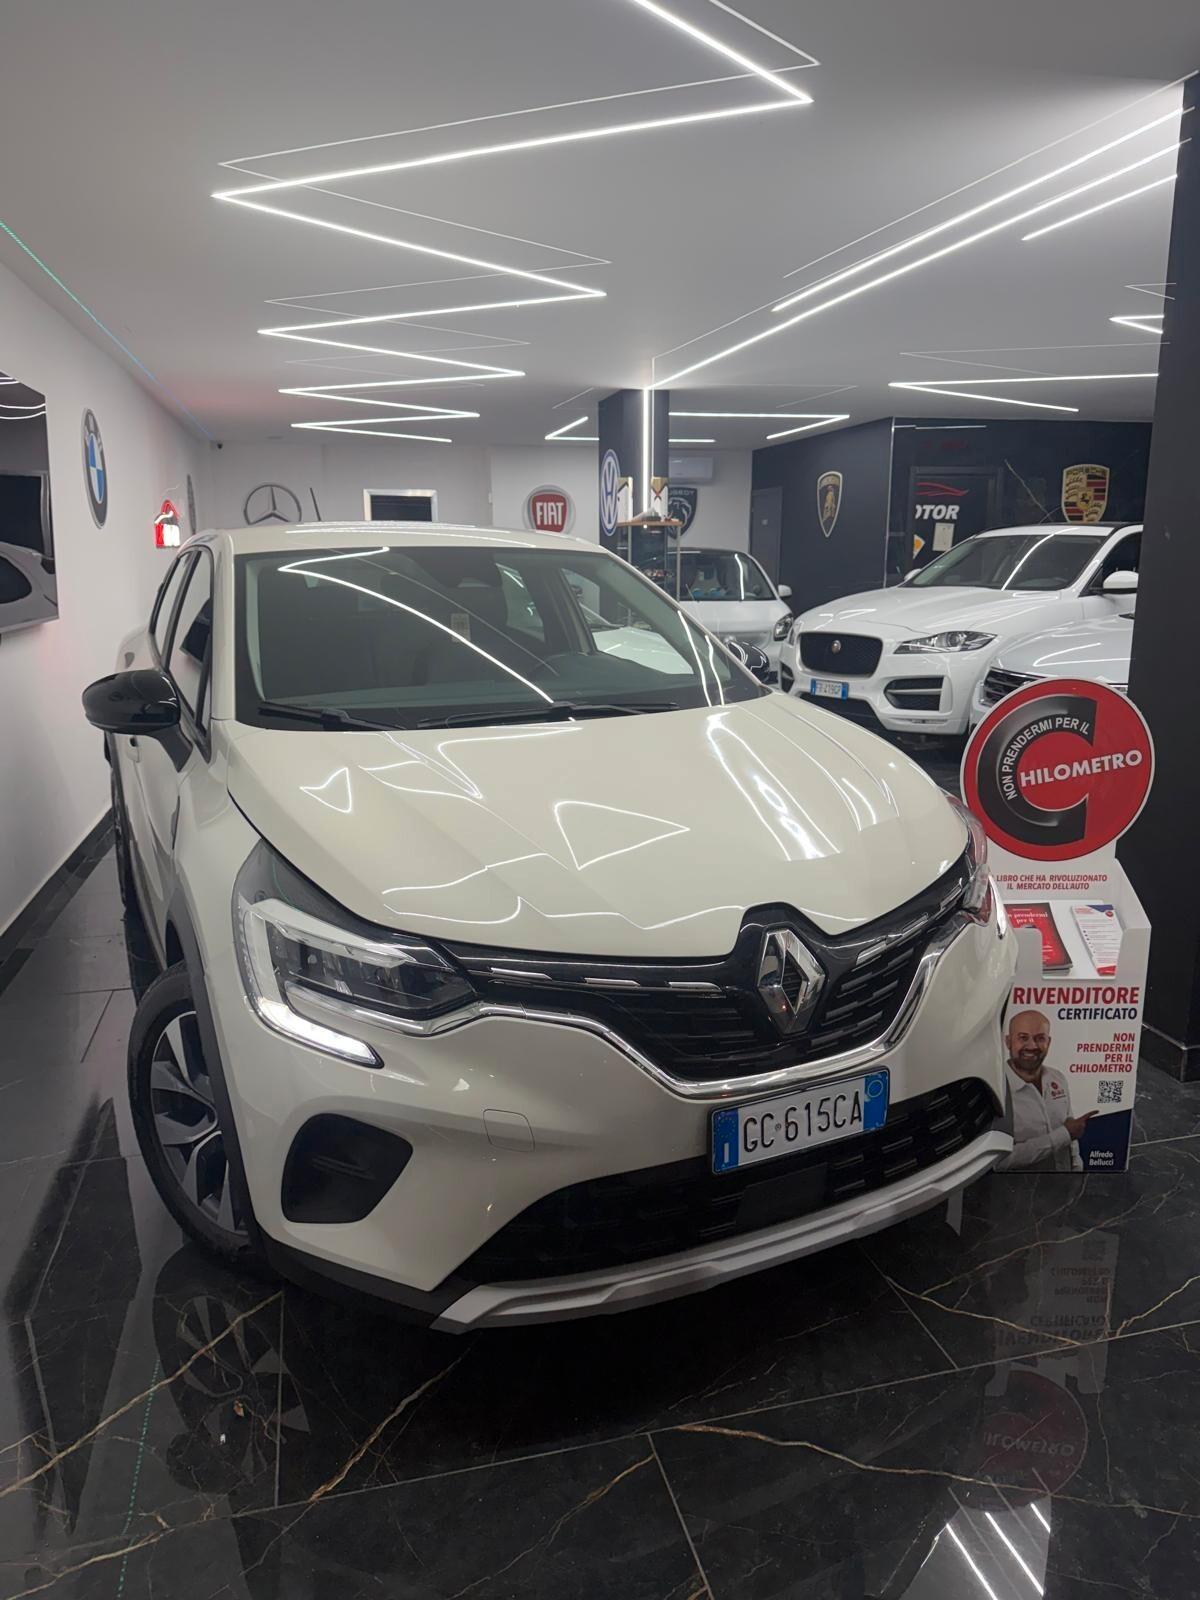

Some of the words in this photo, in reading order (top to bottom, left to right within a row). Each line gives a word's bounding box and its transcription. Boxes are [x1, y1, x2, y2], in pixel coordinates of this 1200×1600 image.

[535, 501, 565, 526] FIAT
[1055, 717, 1078, 730] PER
[1079, 721, 1090, 735] IL
[1002, 719, 1053, 772] PRENDERMI
[1020, 749, 1143, 787] HILOMETRO
[1002, 775, 1018, 800] NON
[996, 874, 1018, 882] LIBRO
[1020, 874, 1034, 882] CHE
[1036, 874, 1046, 882] HA
[1049, 874, 1108, 882] RIVOLUZIONATO
[1007, 882, 1014, 890] IL
[1016, 882, 1051, 890] MERCATO
[1013, 987, 1140, 1005] RIVENDITORE
[1057, 1008, 1138, 1020] CERTIFICATO
[1113, 1033, 1136, 1042] NON
[1076, 1043, 1135, 1053] PRENDERMI
[1104, 1054, 1124, 1063] PER
[1126, 1054, 1135, 1063] IL
[1069, 1064, 1133, 1073] CHILOMETRO
[743, 1112, 775, 1153] GC
[784, 1091, 863, 1142] 615CA
[1089, 1150, 1114, 1158] Alfredo
[1089, 1158, 1114, 1166] Bellucci
